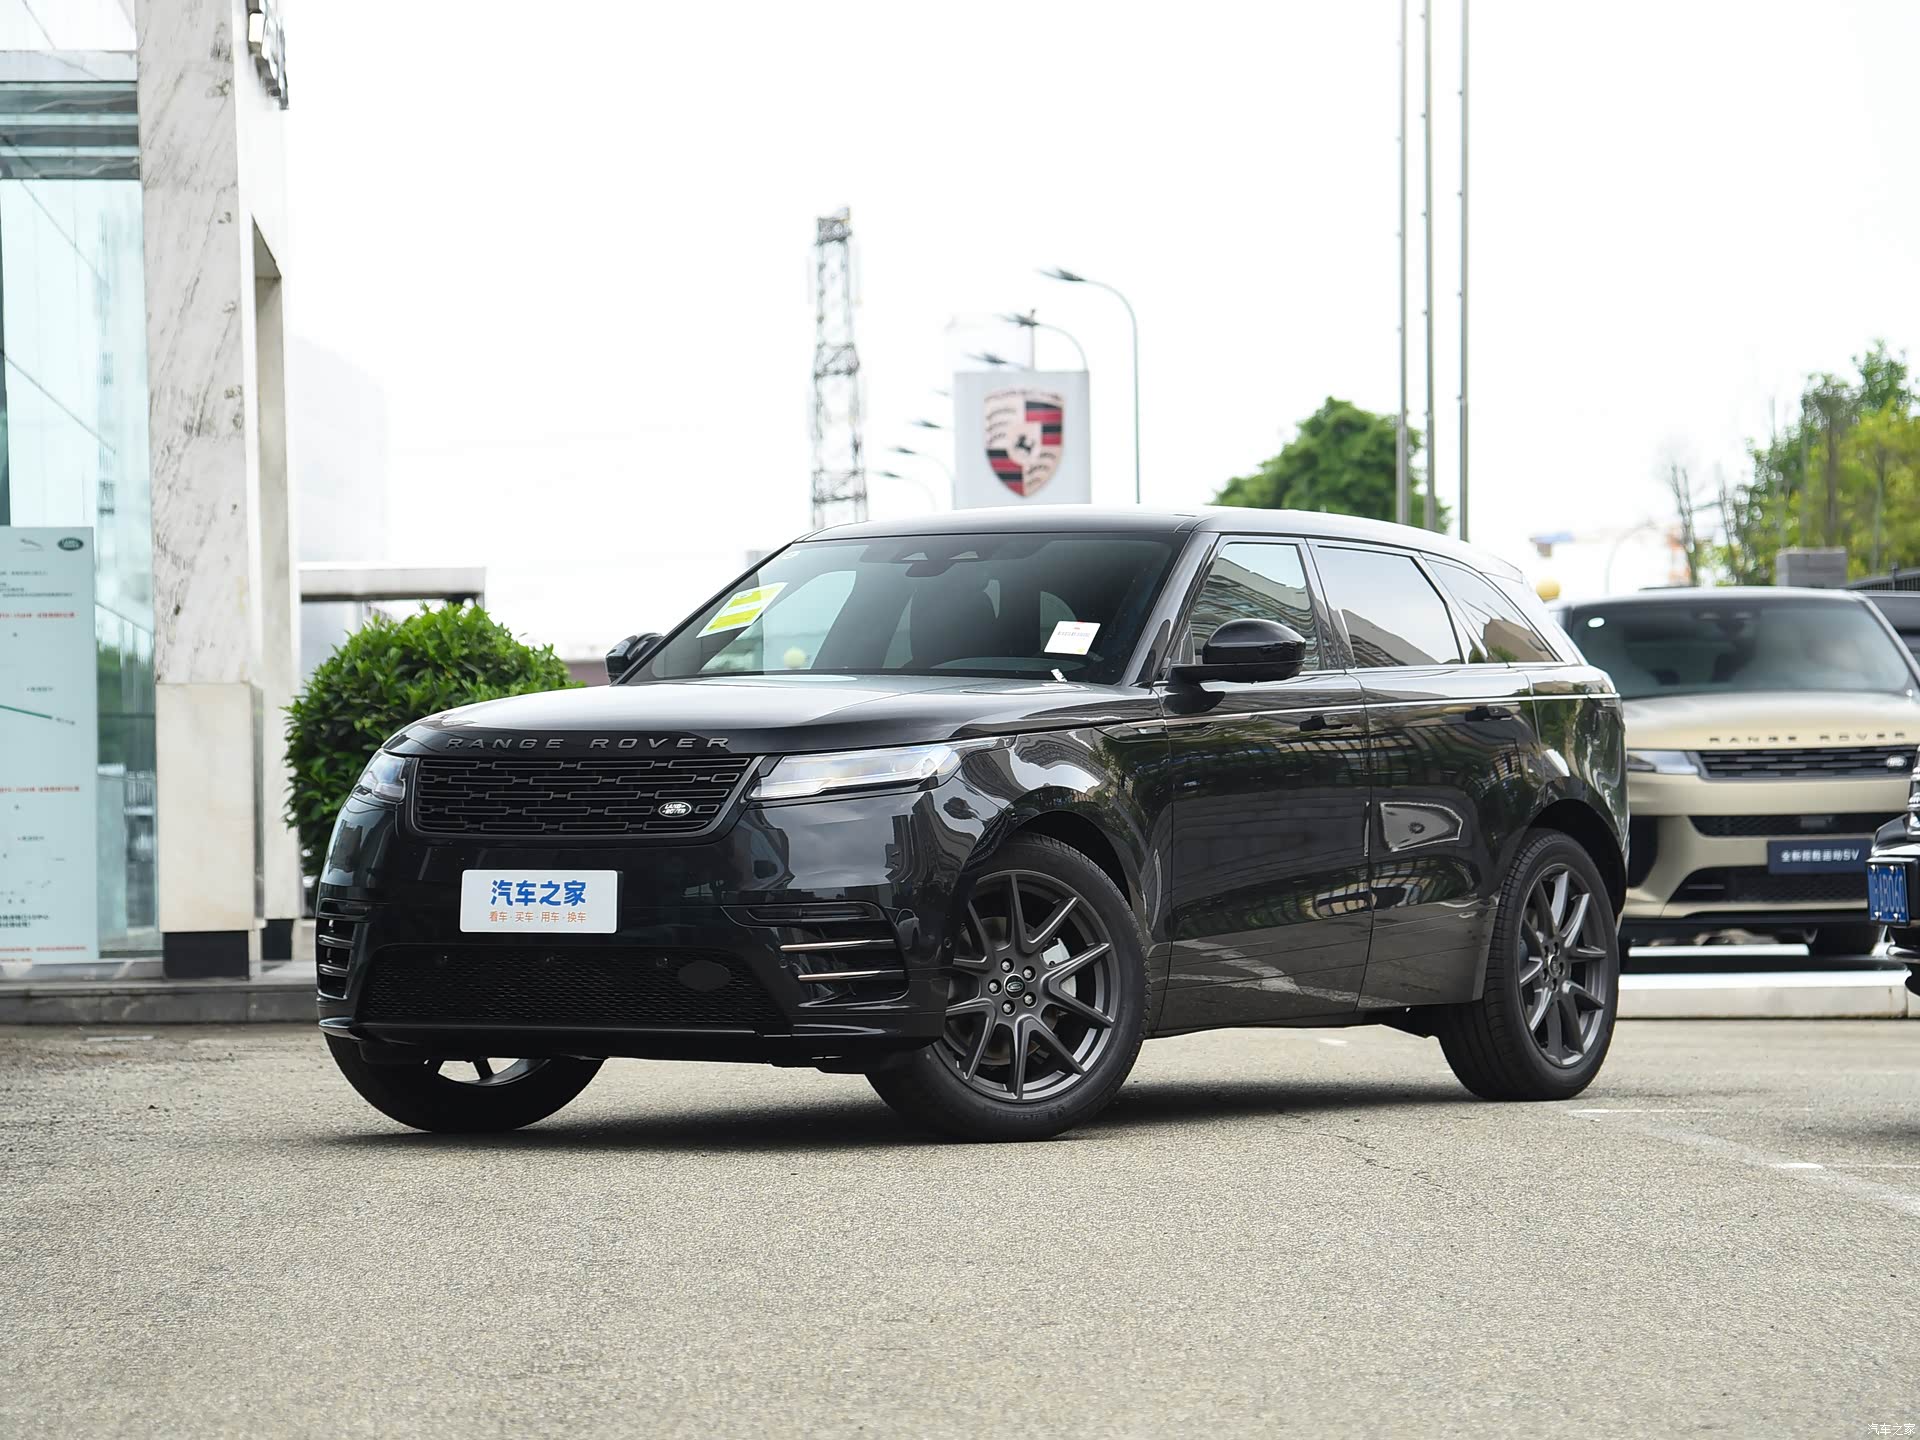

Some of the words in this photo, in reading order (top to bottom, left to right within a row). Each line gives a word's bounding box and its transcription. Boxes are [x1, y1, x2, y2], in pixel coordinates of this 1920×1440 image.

[445, 738, 565, 750] RANGE
[589, 737, 731, 749] ROVER
[1709, 735, 1797, 743] RANGE
[1819, 732, 1906, 741] ROVER
[490, 879, 587, 906] 汽车之家
